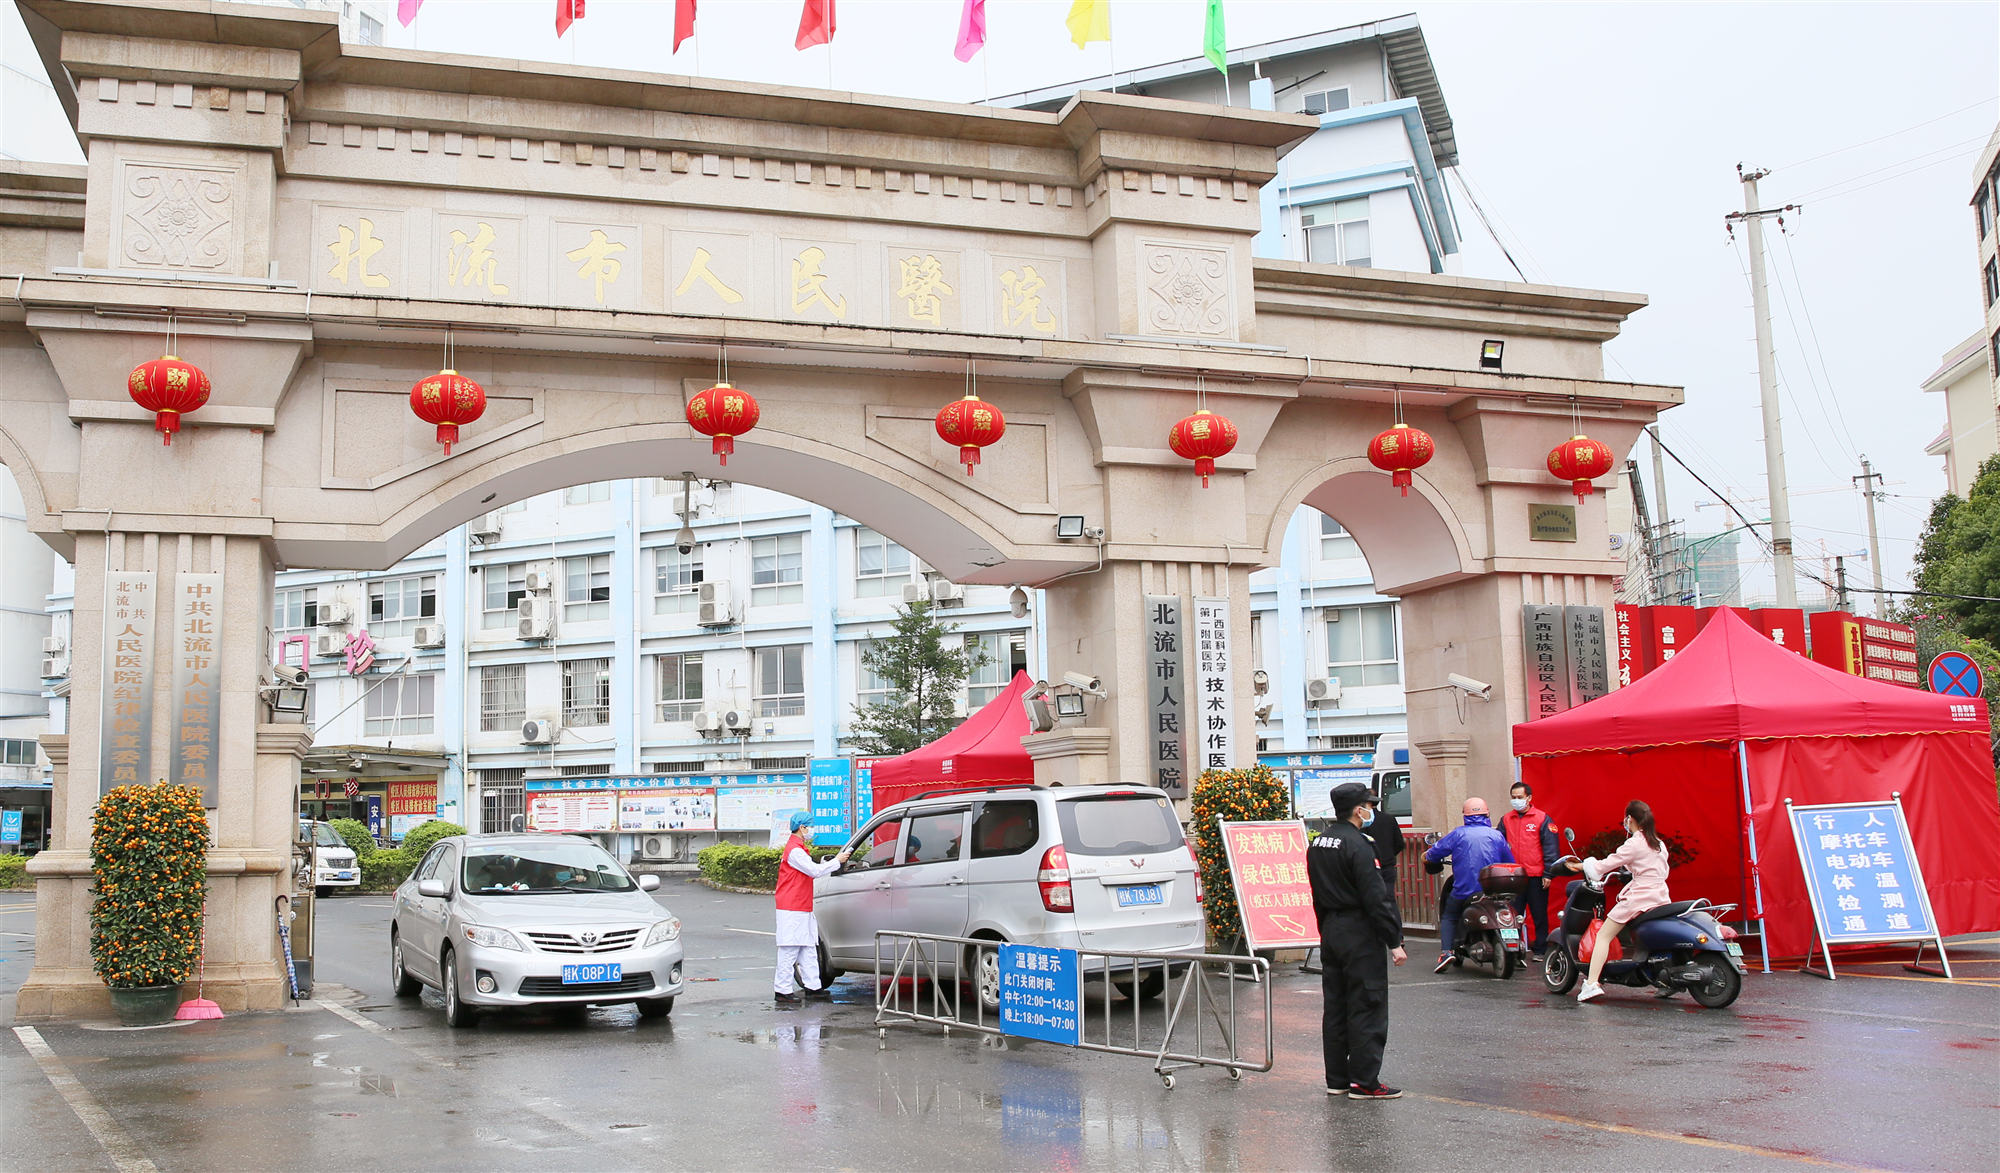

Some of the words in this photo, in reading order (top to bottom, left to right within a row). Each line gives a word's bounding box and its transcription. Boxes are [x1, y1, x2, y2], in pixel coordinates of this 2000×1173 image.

[1199, 608, 1213, 672] 第一附属医院
[1213, 608, 1227, 672] 广西医科大学
[278, 629, 376, 676] 门诊
[1588, 613, 1603, 691] 北流市人民医院
[111, 623, 144, 787] 人民医院纪律检查委员
[1153, 603, 1181, 790] 北流市人民医院
[1286, 755, 1324, 766] 诚信
[315, 777, 360, 799] 门诊
[757, 775, 785, 785] 民主
[1813, 812, 1885, 830] 行人
[1235, 831, 1302, 855] 发热病人
[1820, 832, 1889, 850] 摩托车
[1825, 852, 1895, 869] 电动车
[1242, 862, 1310, 885] 绿色通道
[1832, 872, 1900, 890] 体温
[1837, 892, 1905, 911] 检测
[1843, 913, 1912, 932] 通道
[1015, 951, 1062, 972] 温馨提示
[1004, 972, 1056, 991] 此门关闭时间:
